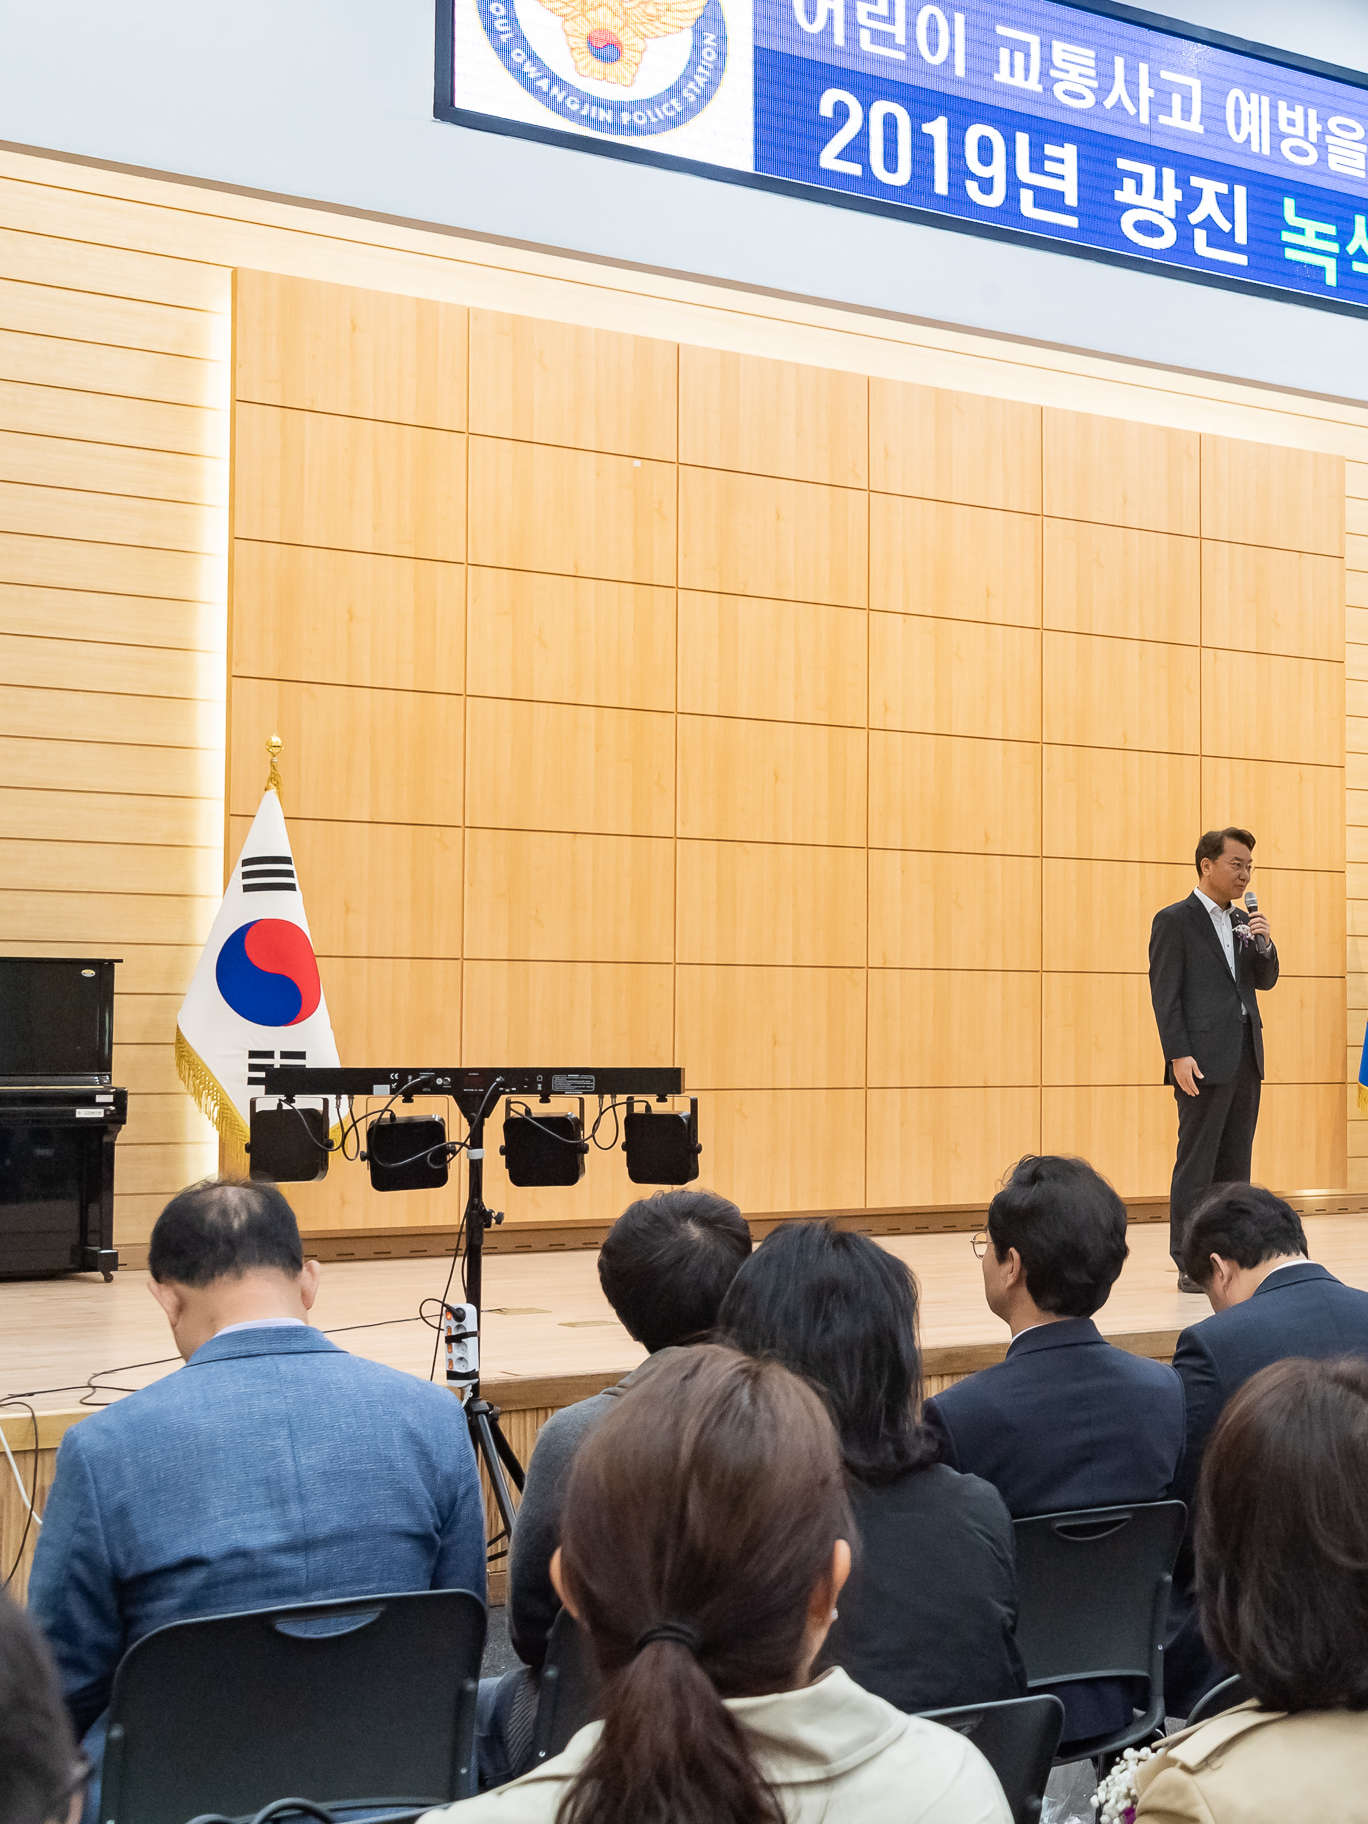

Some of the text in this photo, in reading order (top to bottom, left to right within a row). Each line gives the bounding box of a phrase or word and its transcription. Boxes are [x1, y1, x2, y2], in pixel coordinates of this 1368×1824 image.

[621, 97, 684, 126] POLICE
[683, 31, 718, 102] STATION
[793, 0, 966, 77] 어린이
[994, 25, 1205, 134] 교통사고
[1226, 87, 1368, 180] 예방을
[820, 88, 1079, 229] 2019년
[1115, 157, 1248, 267] 광진
